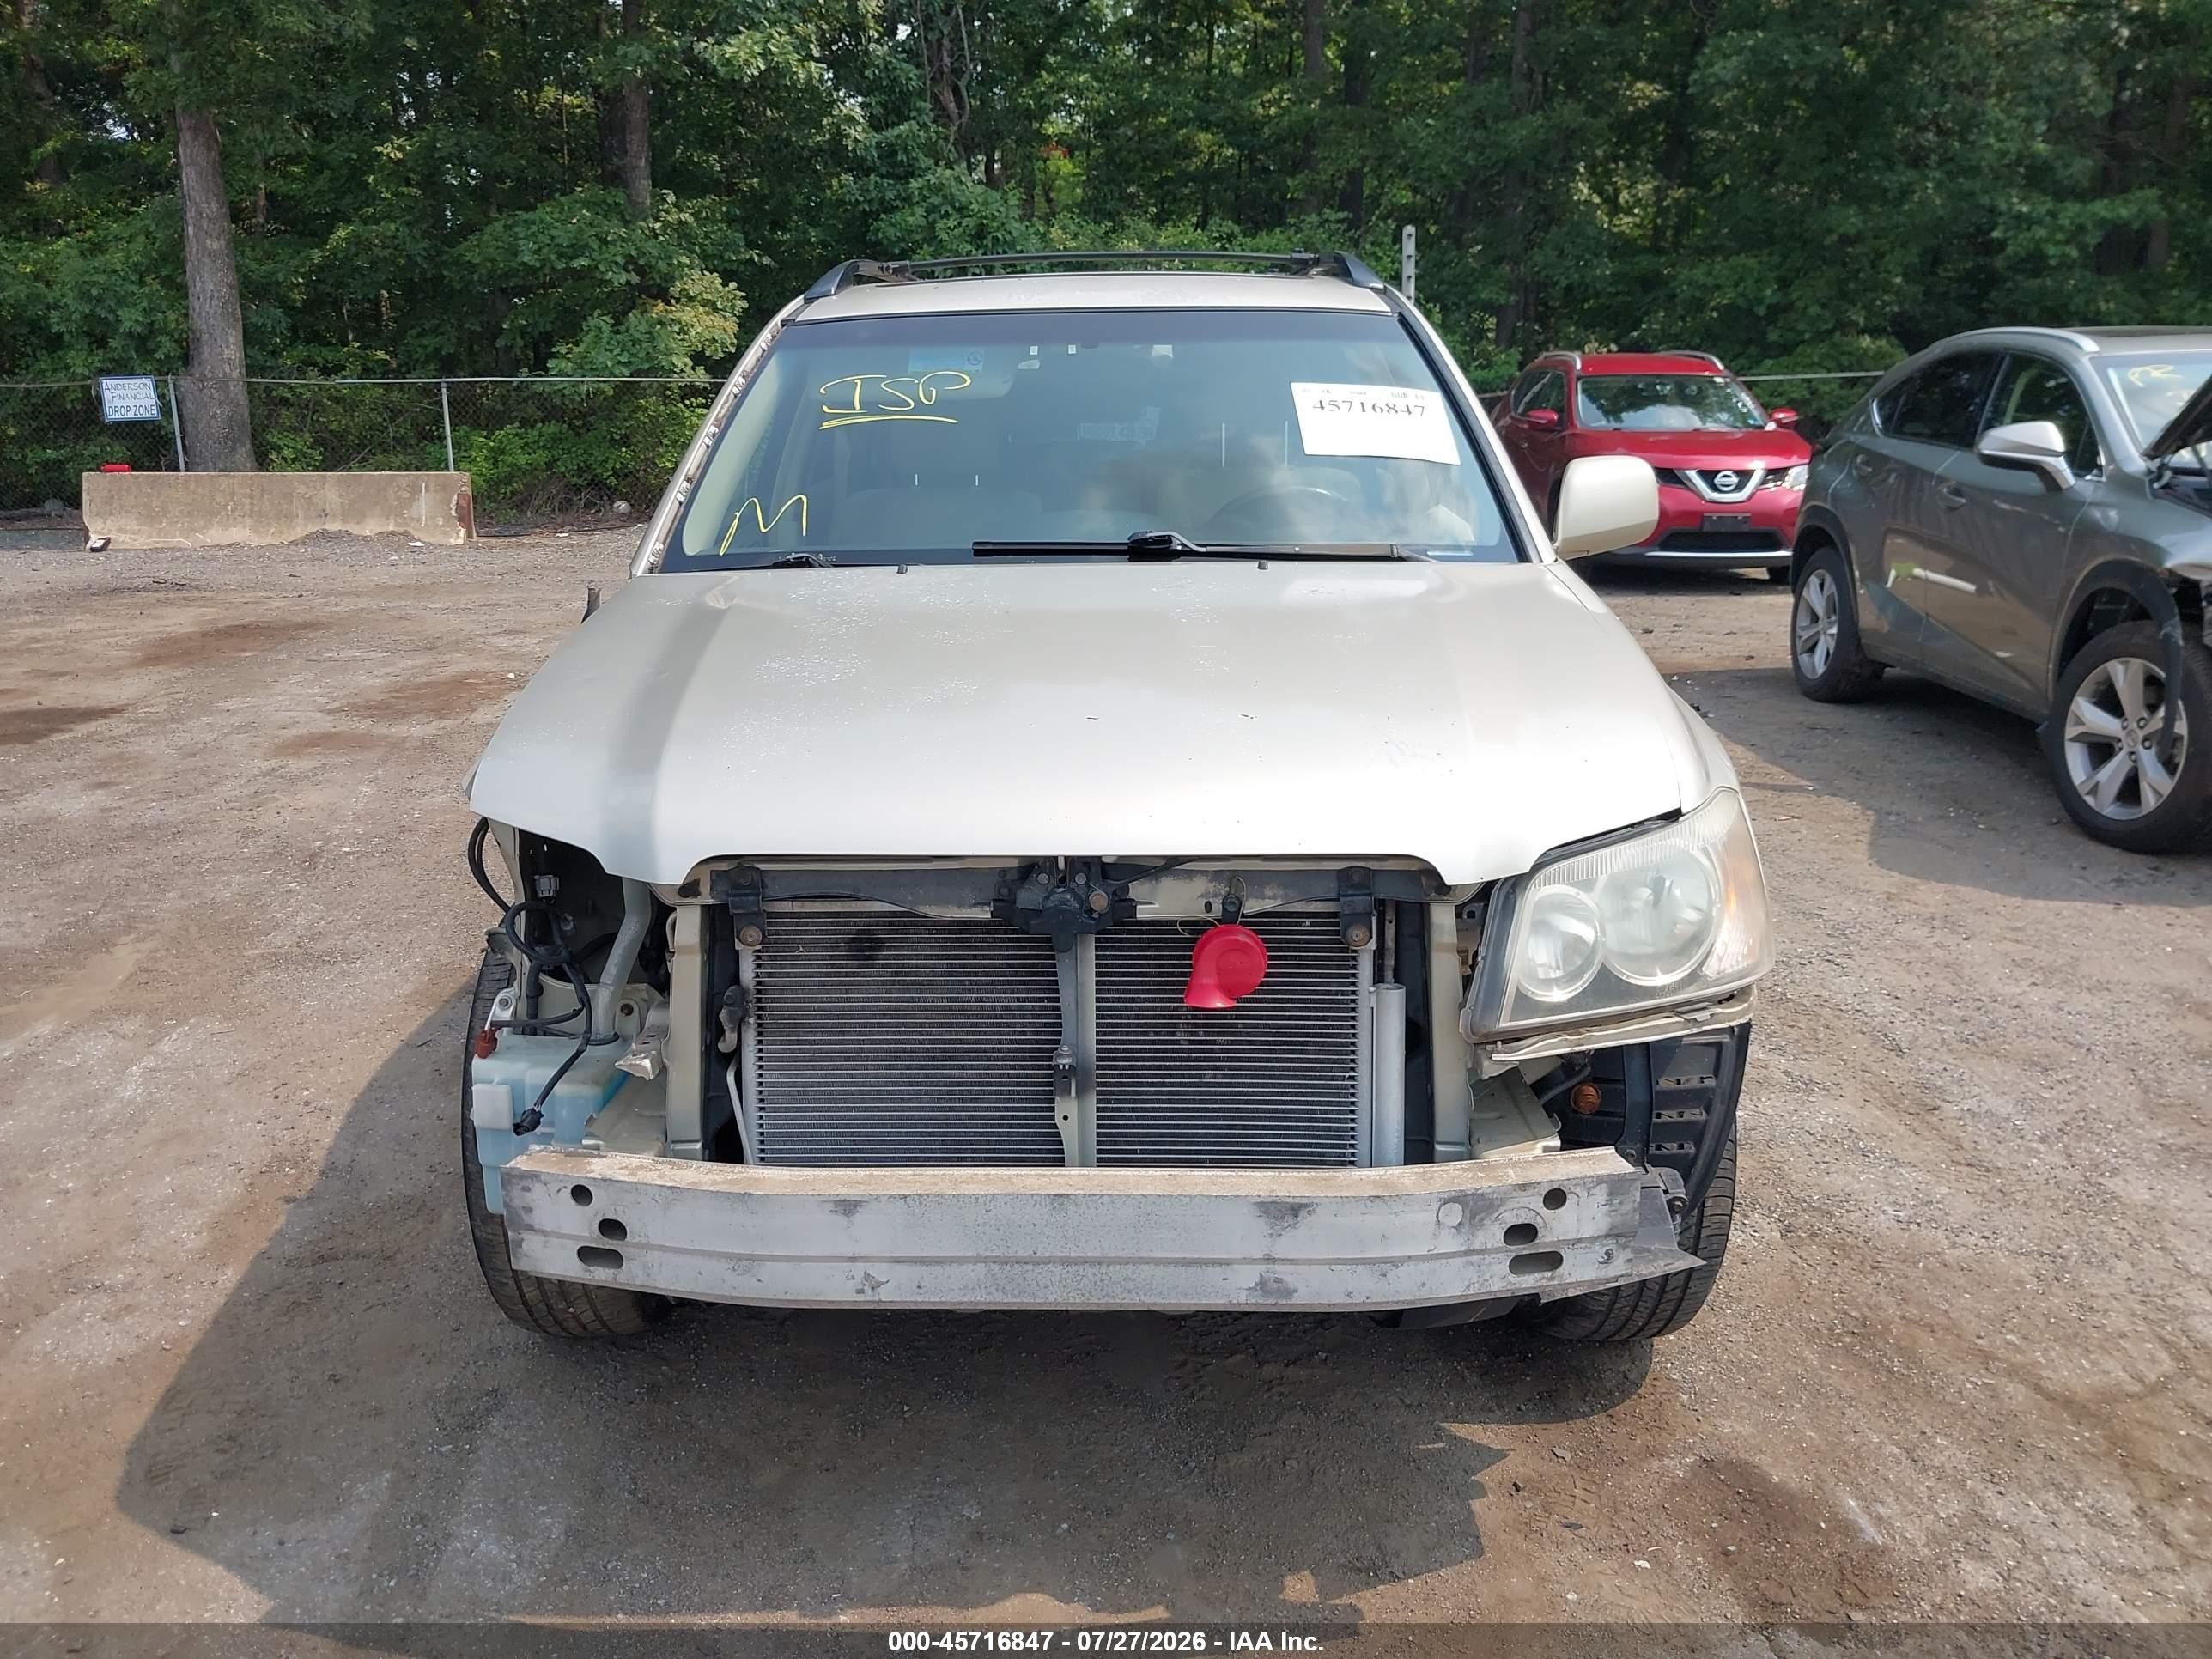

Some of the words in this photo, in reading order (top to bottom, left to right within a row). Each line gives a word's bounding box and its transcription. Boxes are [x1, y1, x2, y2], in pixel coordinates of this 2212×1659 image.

[104, 381, 151, 392] ANDERSON
[111, 392, 155, 402] FINANCIAL
[108, 405, 131, 416] DROP
[133, 404, 156, 416] ZONE
[1312, 399, 1425, 416] 45716847
